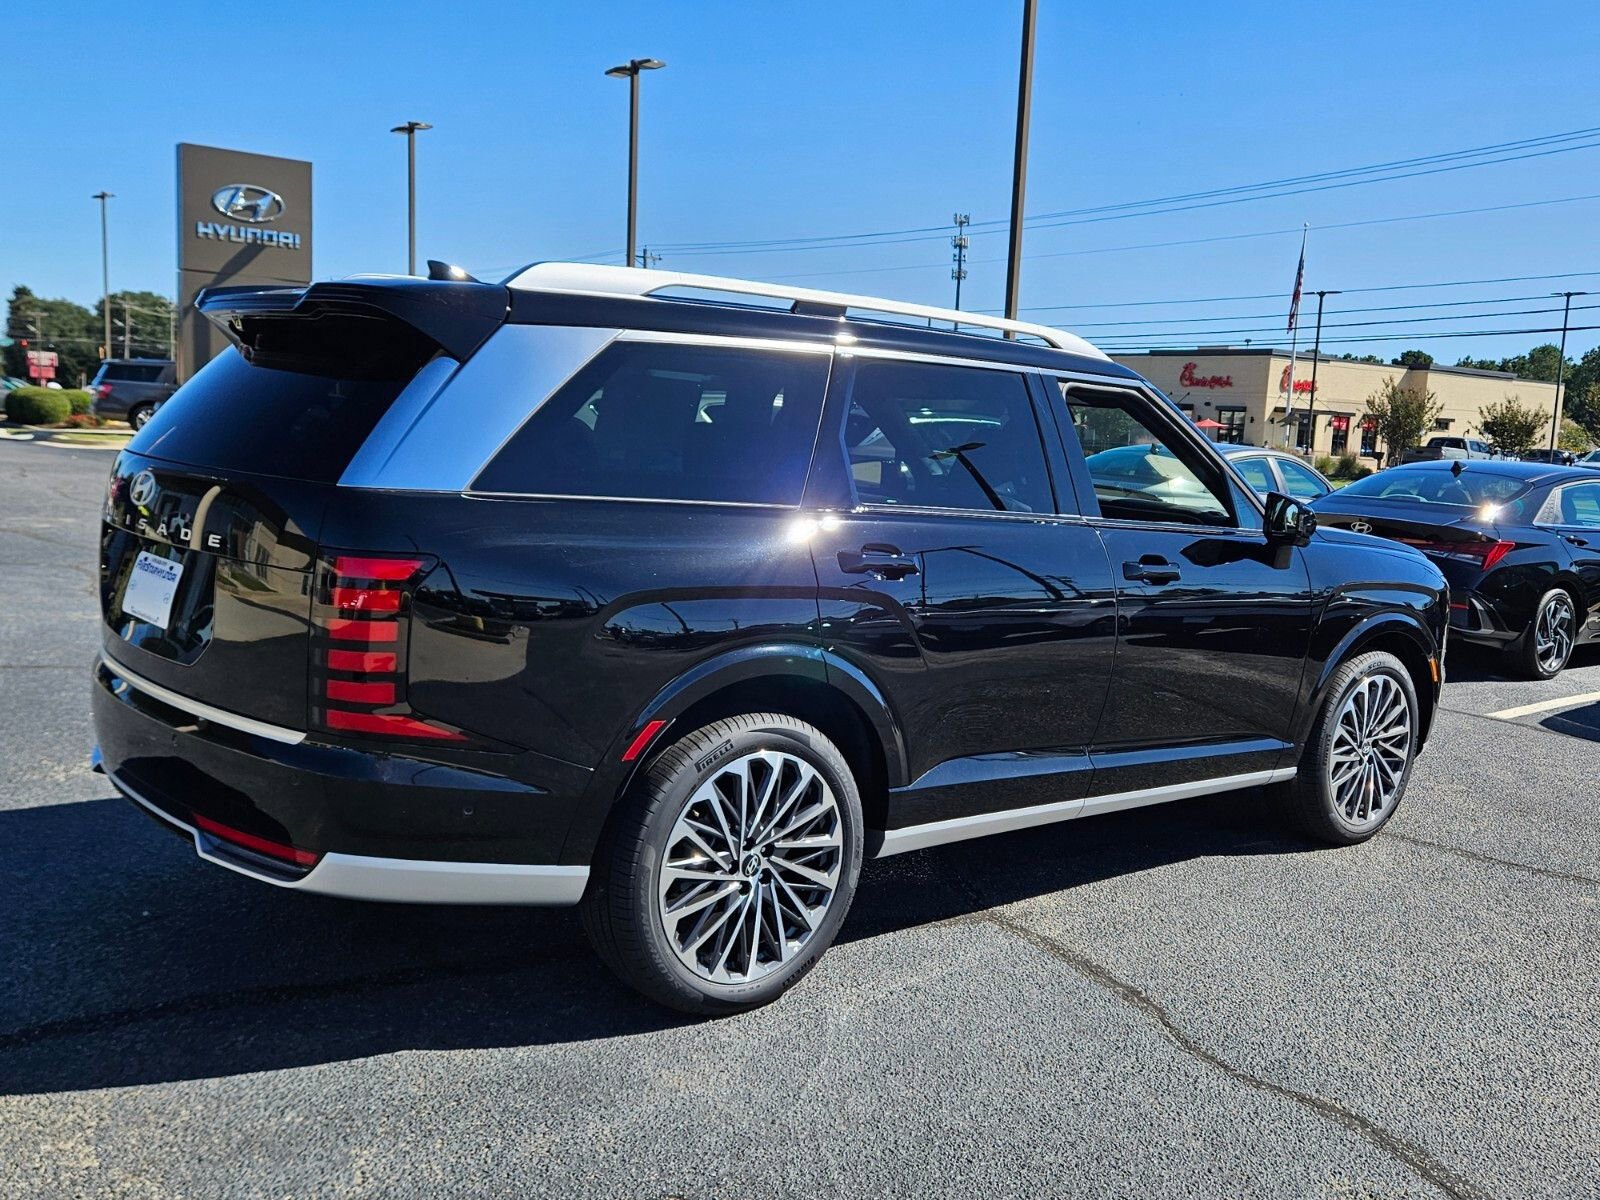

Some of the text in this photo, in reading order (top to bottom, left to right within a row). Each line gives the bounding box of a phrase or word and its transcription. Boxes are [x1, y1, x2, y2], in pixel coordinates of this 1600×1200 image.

[197, 221, 300, 248] HYUNDAI
[124, 513, 223, 548] ISADE
[693, 738, 735, 773] PIRELLI
